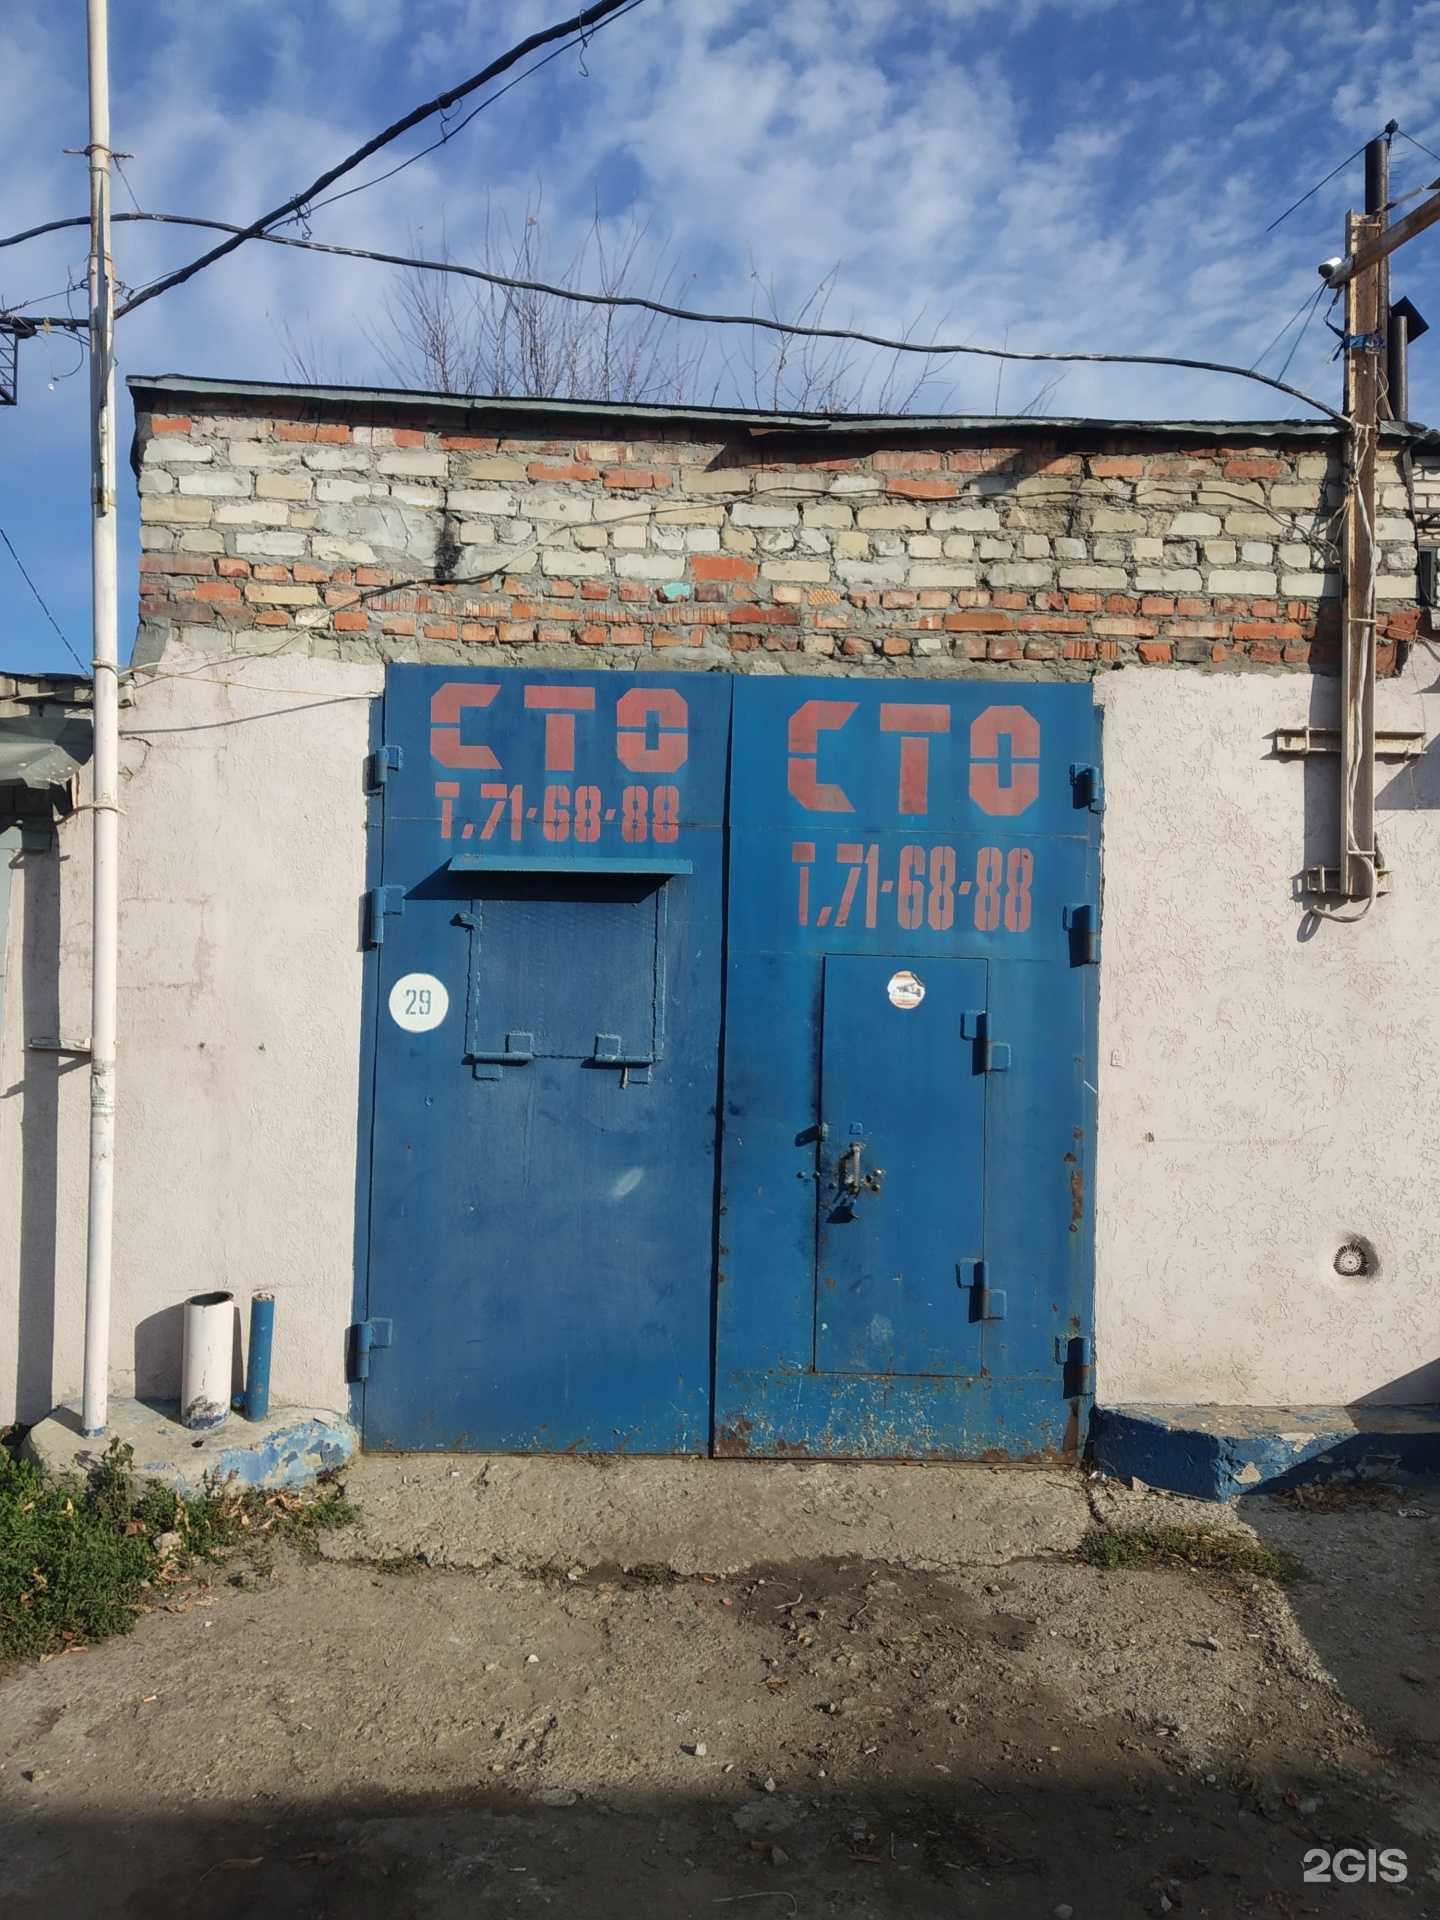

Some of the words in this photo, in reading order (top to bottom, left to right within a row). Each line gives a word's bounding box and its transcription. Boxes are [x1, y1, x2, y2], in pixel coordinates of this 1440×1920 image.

[430, 682, 689, 775] СТО
[787, 699, 1041, 816] СТО
[405, 989, 432, 1015] 29
